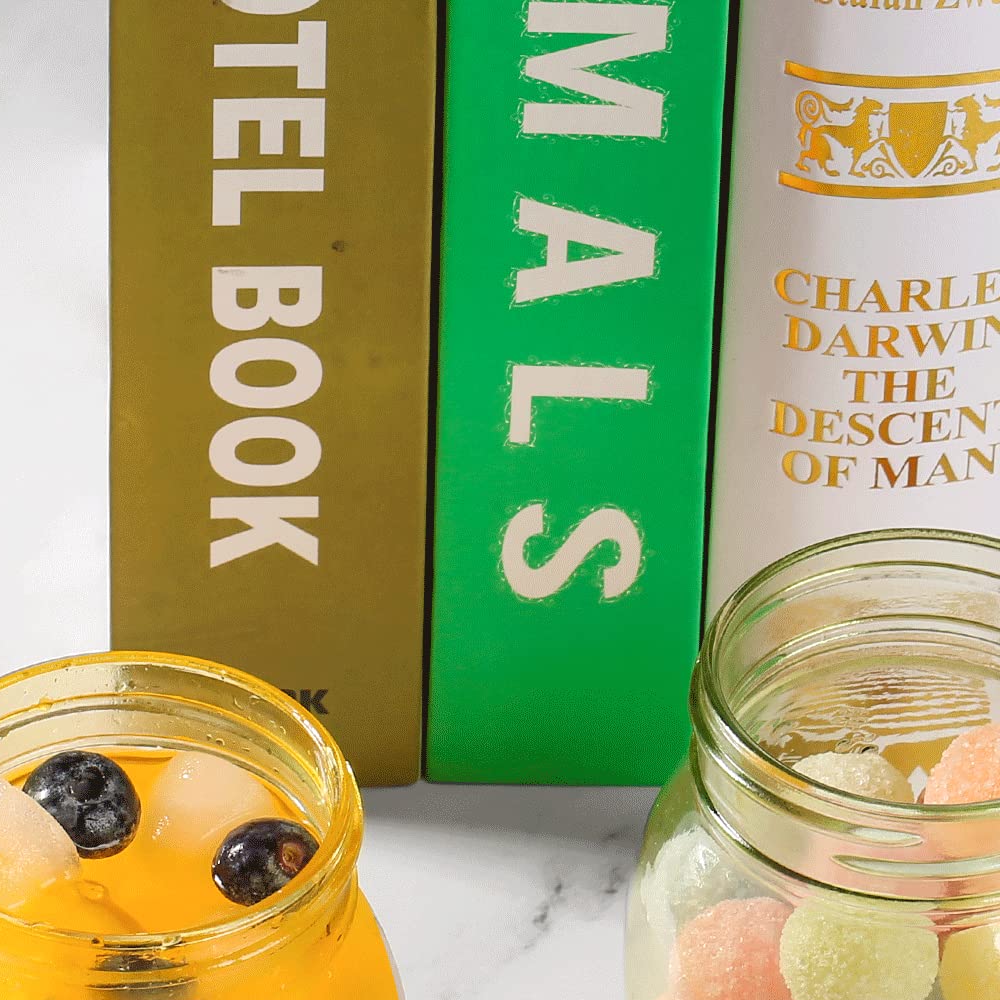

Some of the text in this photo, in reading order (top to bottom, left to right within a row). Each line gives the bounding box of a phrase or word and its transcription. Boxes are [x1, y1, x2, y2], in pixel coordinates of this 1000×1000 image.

[208, 0, 327, 569] TEL BOOK
[499, 1, 671, 603] MALS
[774, 268, 1000, 313] CHARLE
[843, 366, 957, 404] THE
[768, 399, 1000, 447] DESCEN
[782, 443, 1000, 489] OF MAN
